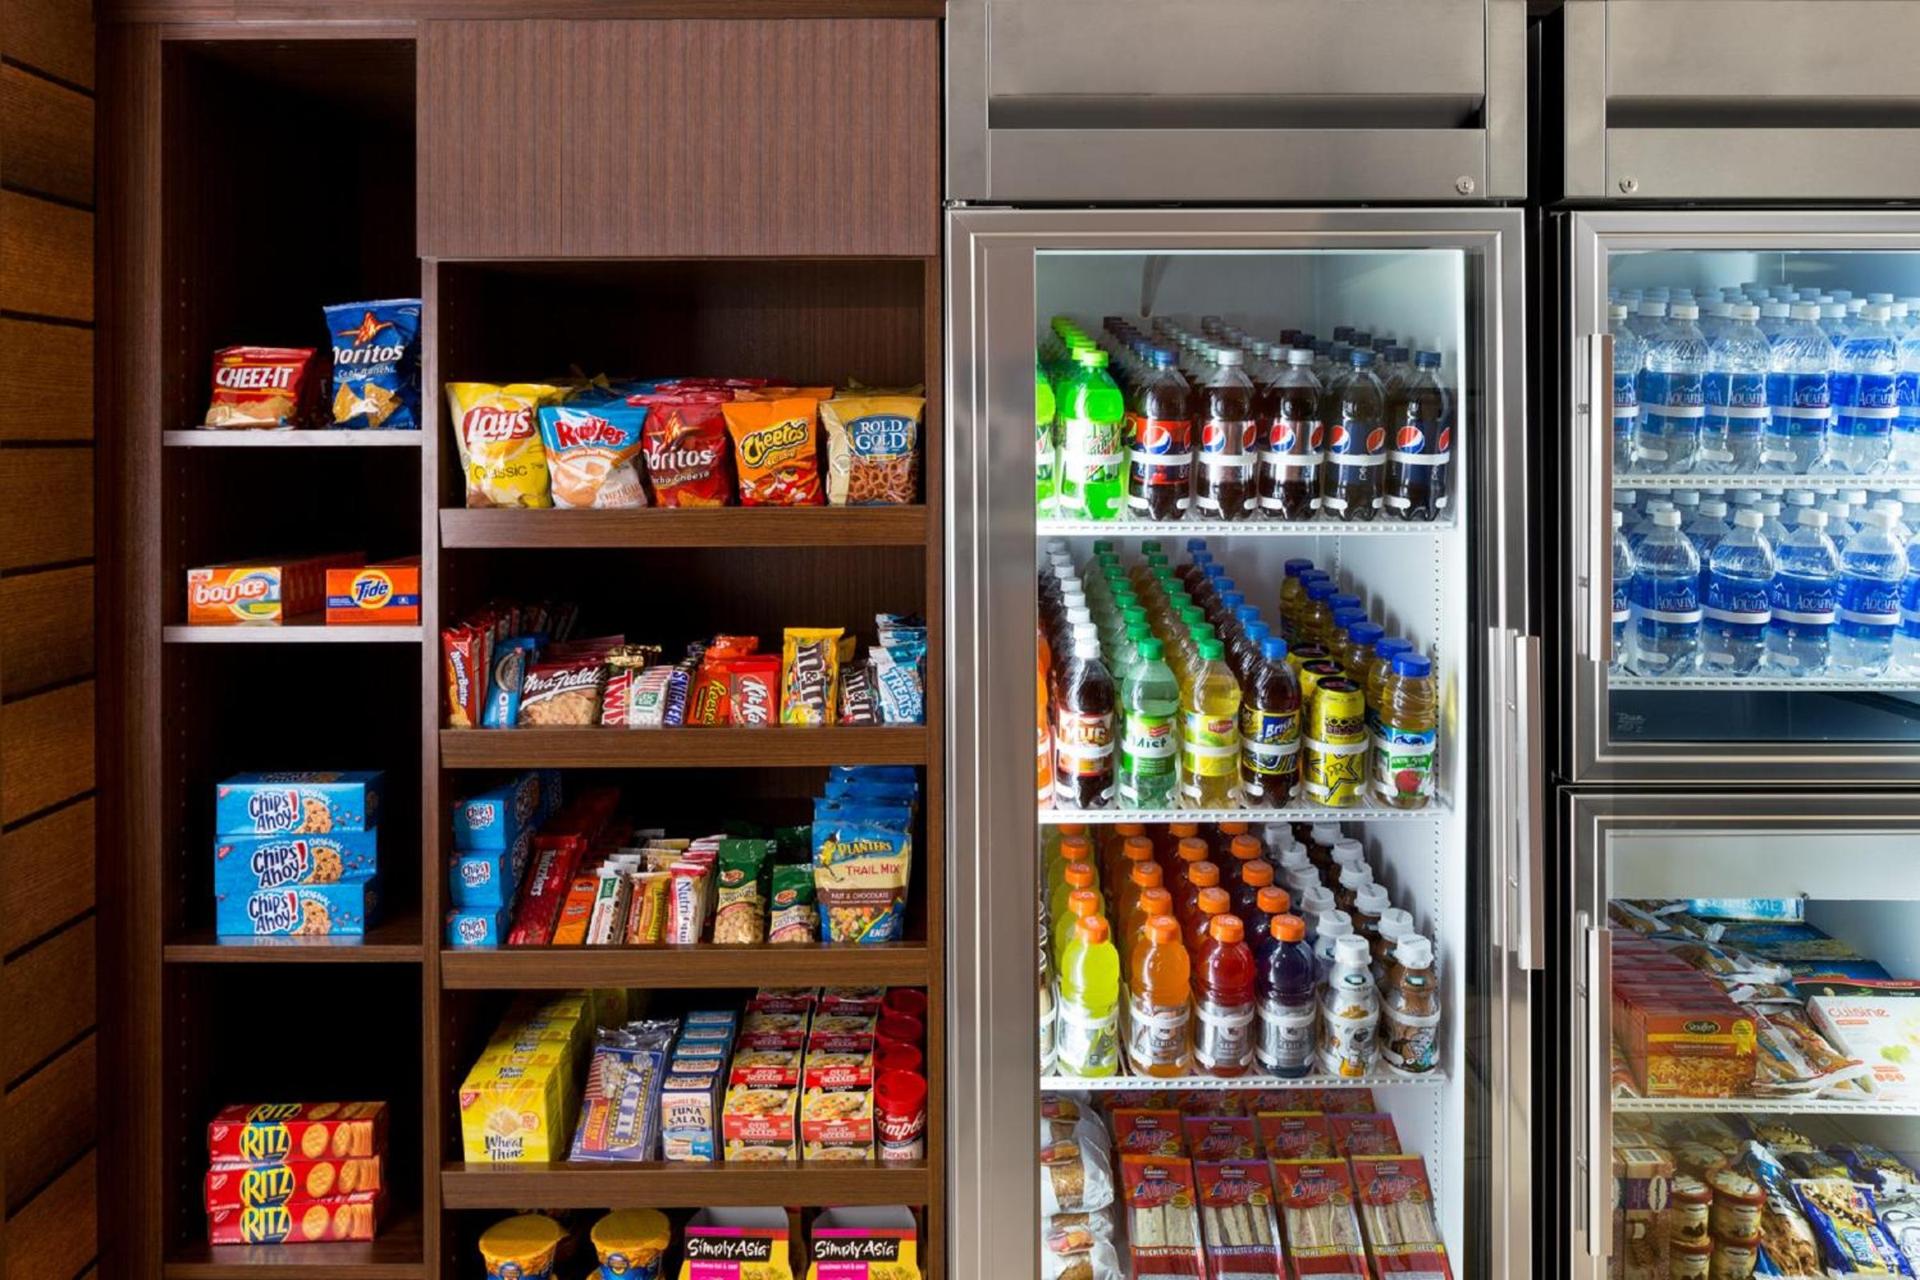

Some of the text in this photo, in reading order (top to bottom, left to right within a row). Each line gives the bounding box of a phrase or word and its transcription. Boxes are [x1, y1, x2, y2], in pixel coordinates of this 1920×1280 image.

[216, 365, 294, 388] CHEEZ-IT
[555, 418, 627, 448] Ruffles
[861, 419, 902, 434] ROLD
[743, 423, 806, 465] Cheetos
[855, 433, 907, 450] GOLD
[195, 580, 265, 604] bounce
[355, 580, 388, 601] Tide
[663, 671, 690, 726] SNICKER
[882, 667, 913, 719] TREATS
[498, 692, 509, 726] ORE
[742, 703, 767, 723] Ka
[250, 794, 290, 818] Chips
[838, 842, 892, 854] PLANTERS
[253, 847, 297, 874] Chips
[846, 864, 900, 876] TRAIL MIX
[249, 894, 288, 918] Chips
[250, 1104, 300, 1121] RITZ
[668, 1117, 706, 1126] SALAD
[672, 1107, 702, 1117] TUNA
[244, 1125, 287, 1160] RITZ
[485, 1136, 523, 1149] Wheat
[244, 1168, 291, 1204] RITZ
[244, 1207, 288, 1240] RITZ
[687, 1238, 768, 1258] Simply Asia
[814, 1240, 897, 1259] Simply Asia
